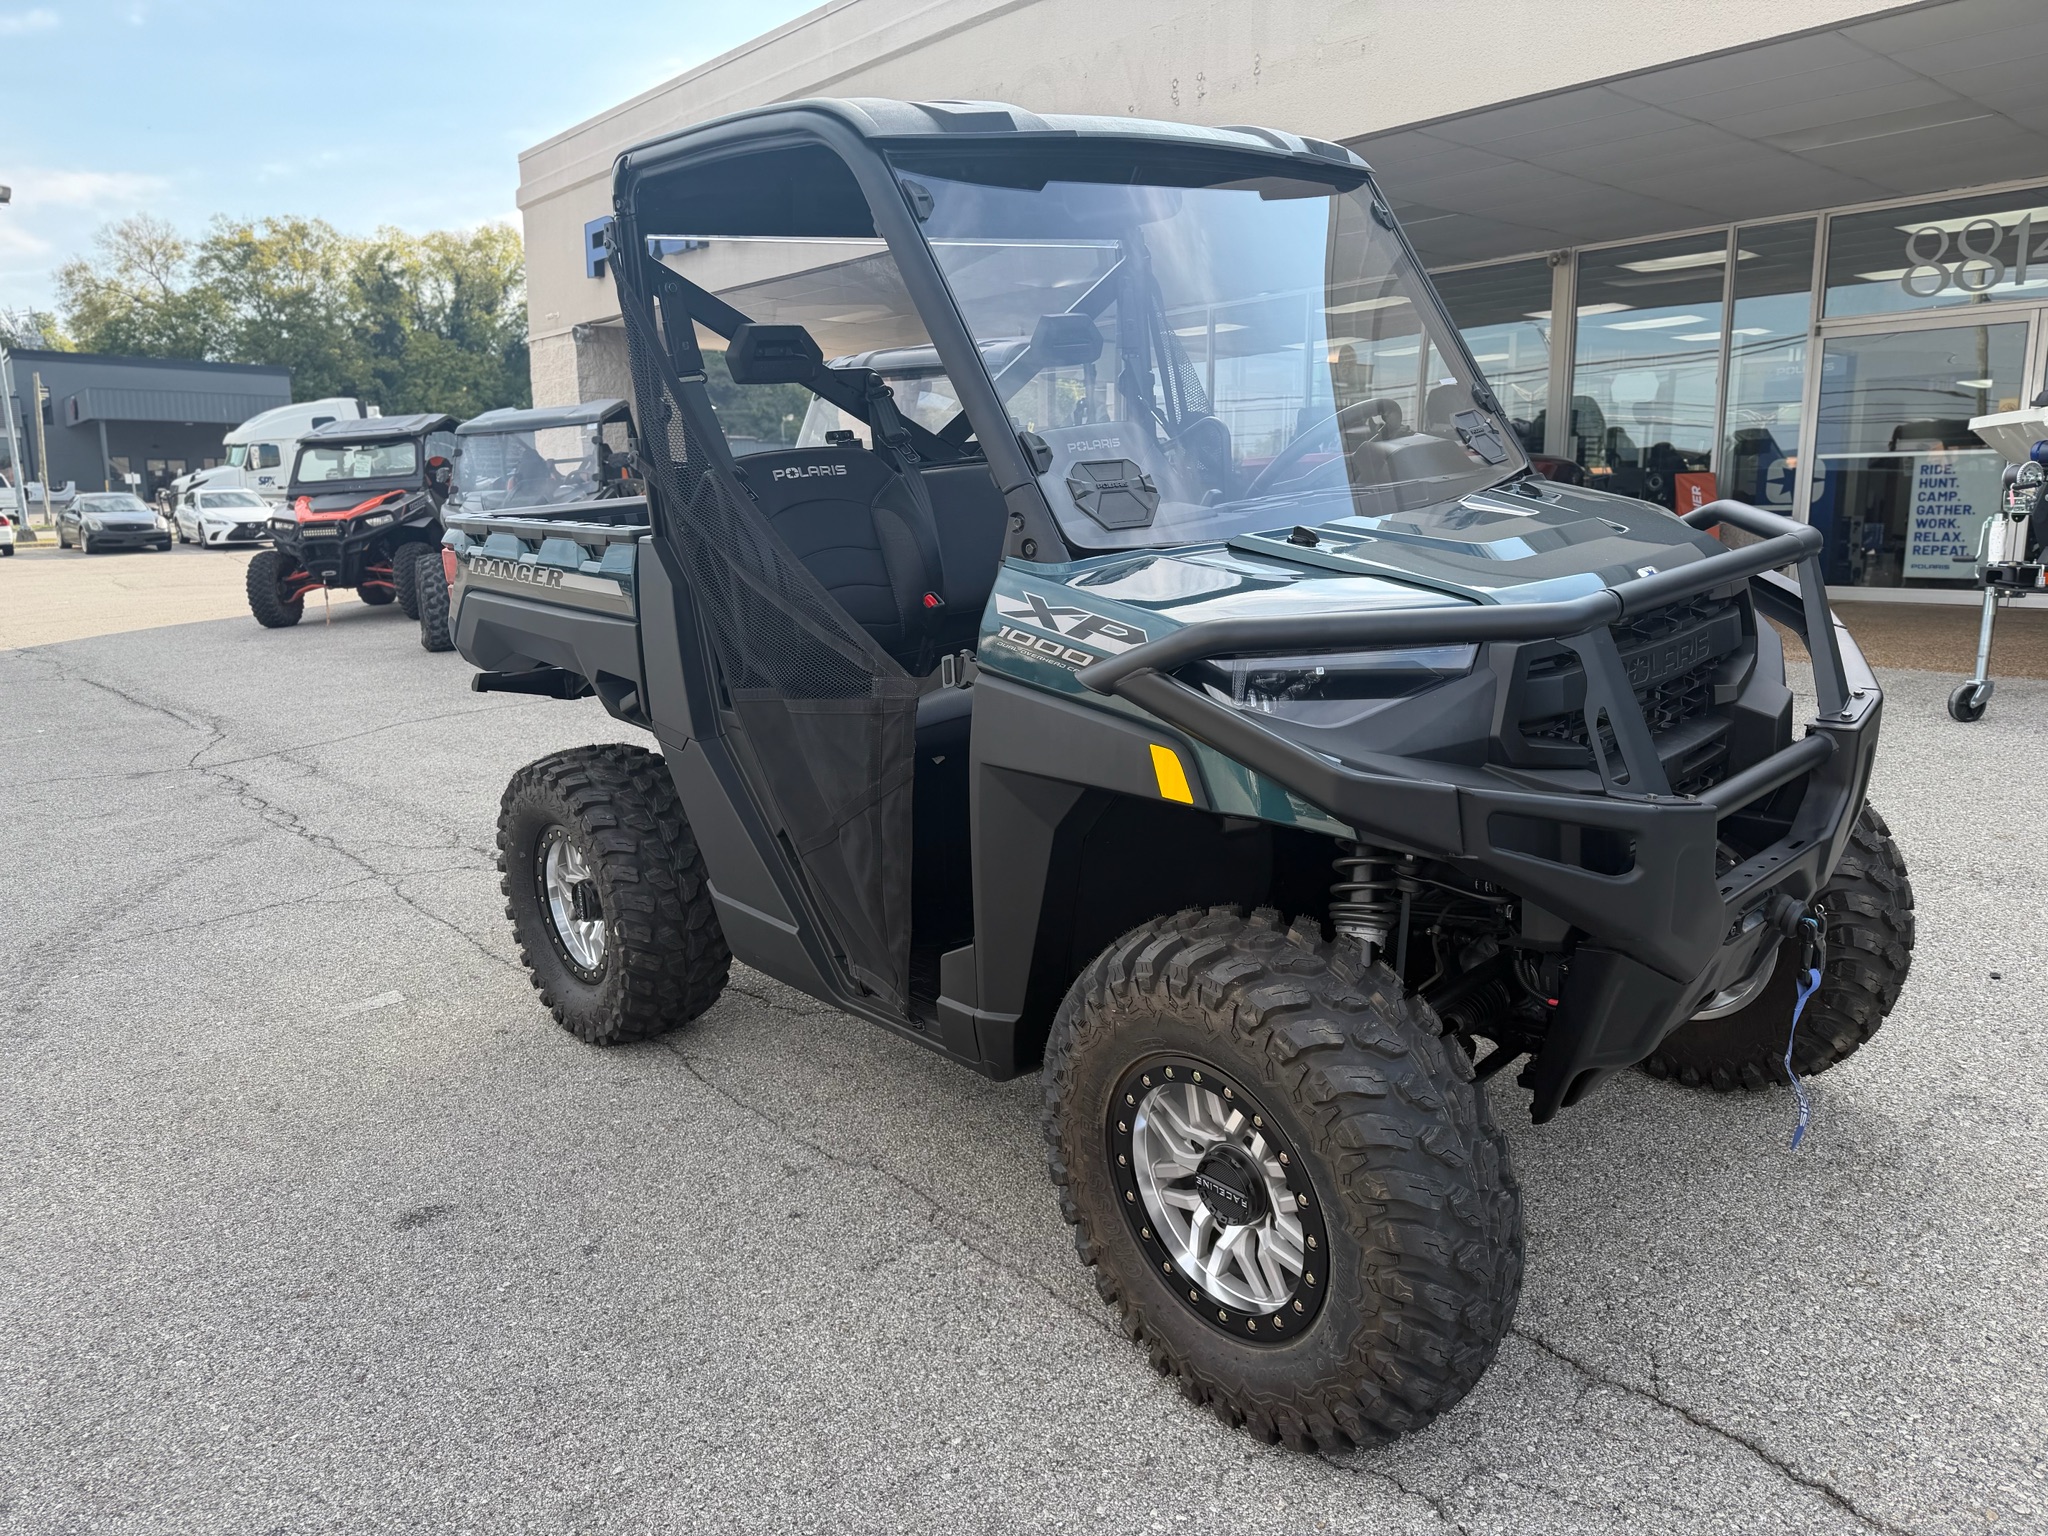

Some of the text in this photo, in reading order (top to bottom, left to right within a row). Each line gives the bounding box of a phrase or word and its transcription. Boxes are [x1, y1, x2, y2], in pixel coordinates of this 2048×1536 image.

[1067, 438, 1121, 453] POLARIS
[772, 465, 848, 481] POLARIS
[1920, 464, 1956, 475] RIDE.
[1919, 478, 1960, 488] HUNT.
[1918, 491, 1961, 502] CAMP.
[1916, 504, 1976, 515] GATHER.
[1915, 518, 1961, 529] WORK.
[1914, 531, 1966, 542] RELAX.
[1912, 545, 1970, 556] REPEAT.
[472, 557, 564, 589] RANGER
[996, 591, 1149, 651] XP
[998, 625, 1094, 667] 1000
[996, 641, 1018, 652] DUAL
[1020, 649, 1067, 669] OVERHEAD
[1622, 631, 1711, 686] OLARIS
[1196, 1176, 1248, 1208] RACELINE
